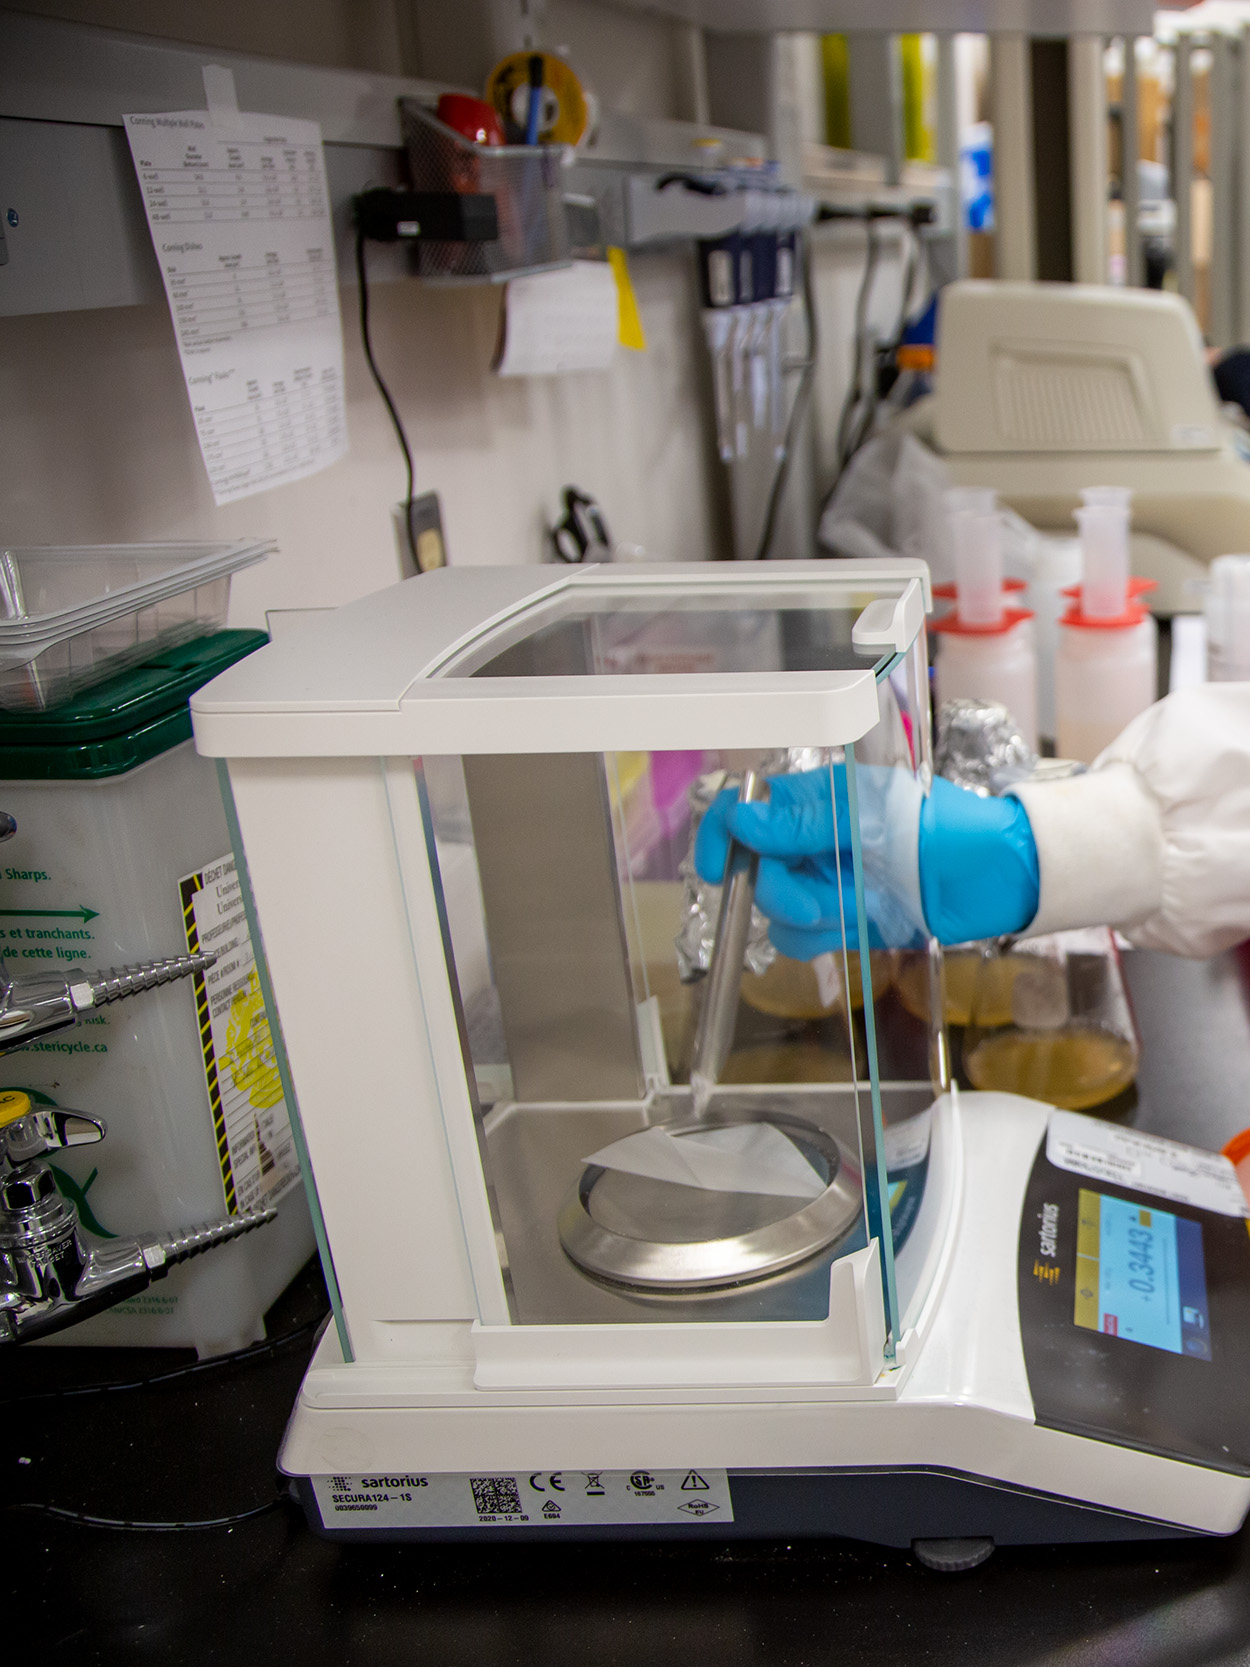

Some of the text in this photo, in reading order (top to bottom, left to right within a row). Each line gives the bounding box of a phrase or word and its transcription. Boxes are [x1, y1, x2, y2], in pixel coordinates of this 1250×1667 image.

[5, 868, 51, 883] Sharps.
[9, 928, 22, 939] et
[25, 928, 95, 940] tranchants.
[3, 946, 91, 961] de cette ligne.
[1038, 1202, 1060, 1258] sartorius
[361, 1475, 429, 1488] sartorius
